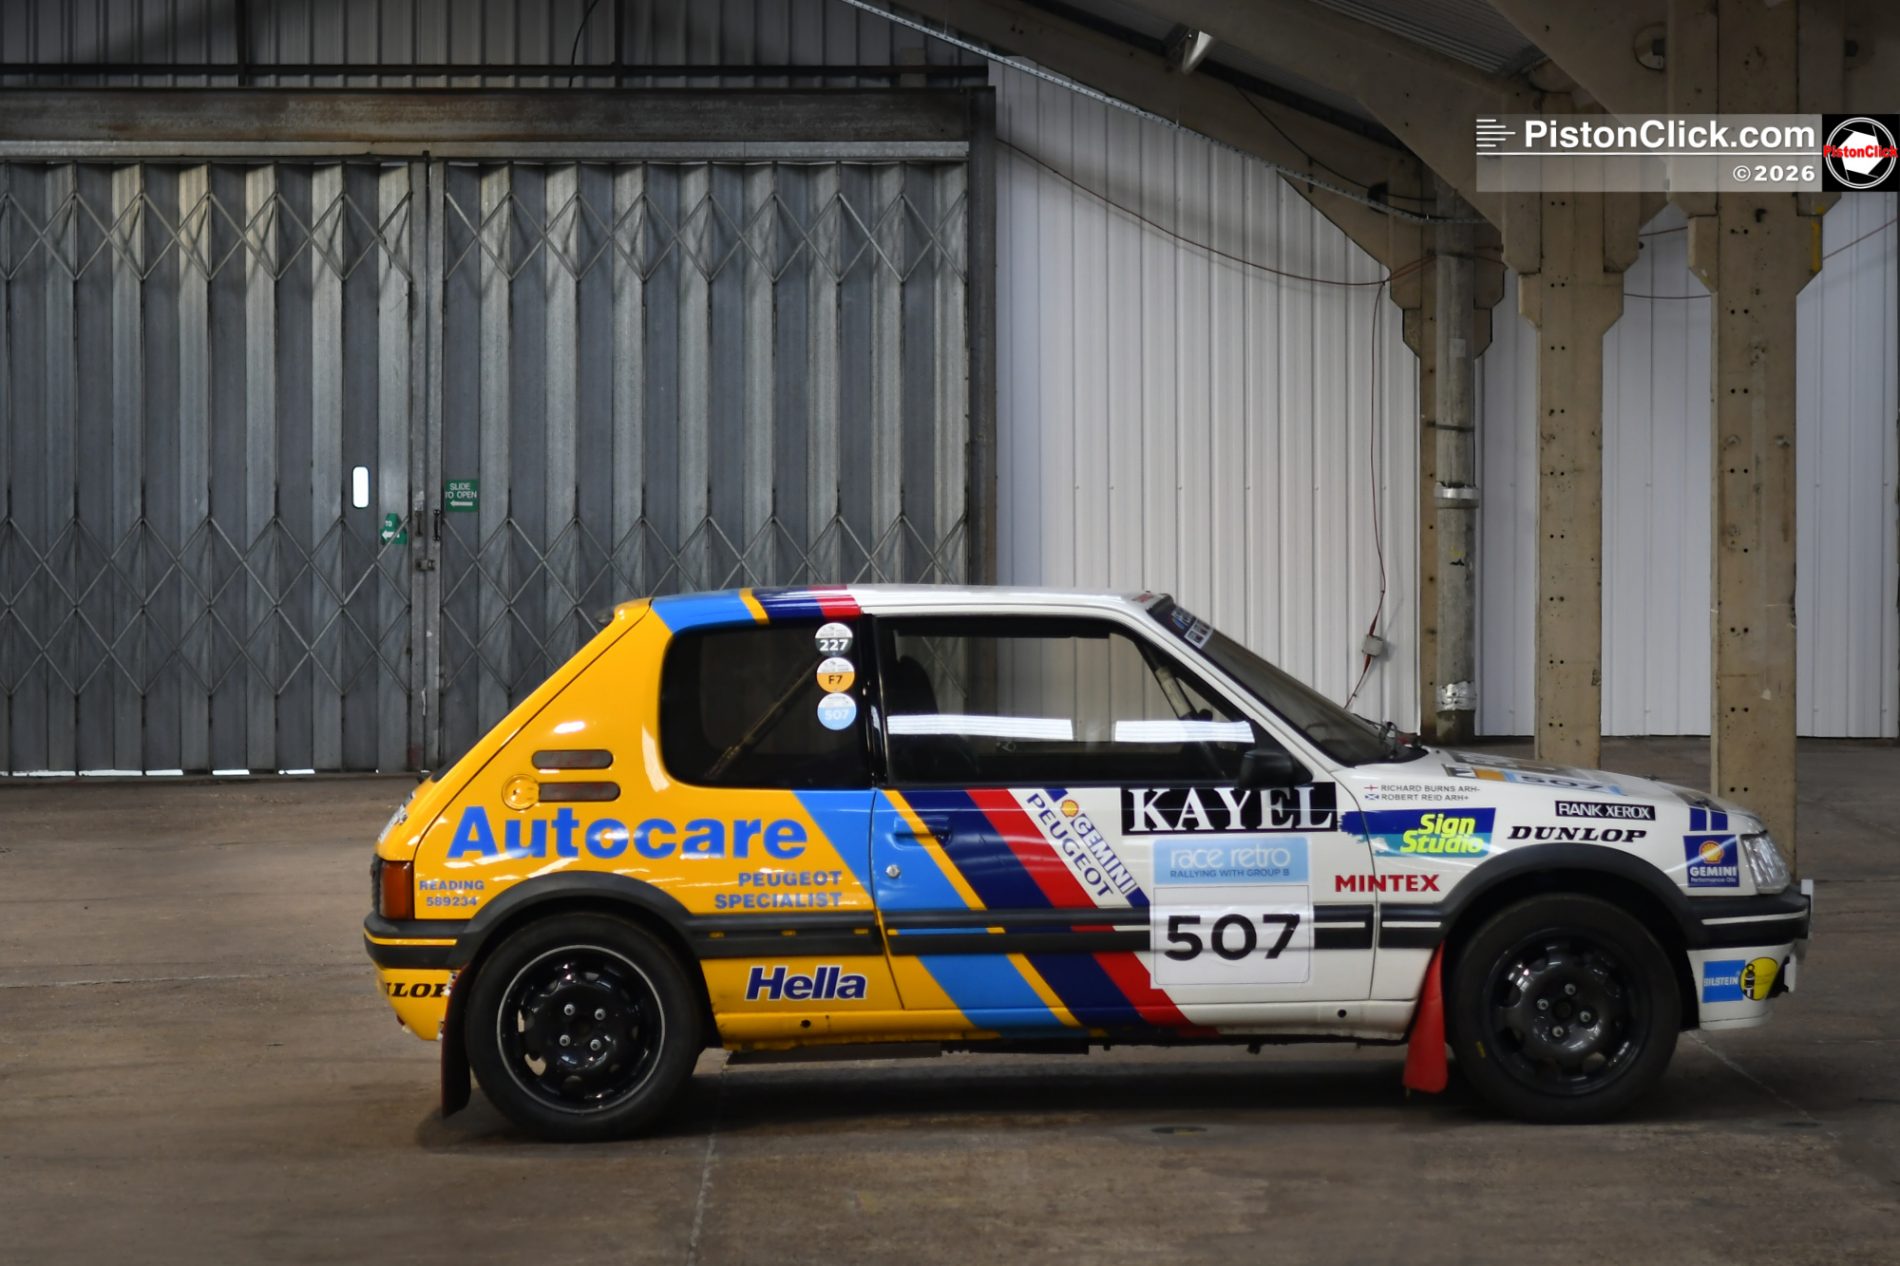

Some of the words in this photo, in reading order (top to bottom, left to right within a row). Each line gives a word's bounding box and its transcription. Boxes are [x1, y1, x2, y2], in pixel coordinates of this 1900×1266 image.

[449, 482, 471, 491] SLIDE
[457, 491, 477, 499] OPEN
[819, 638, 849, 652] 227
[828, 675, 843, 685] F7
[1381, 784, 1422, 793] RICHARD
[1424, 785, 1455, 793] BURNS
[1381, 793, 1420, 801] ROBERT
[1422, 793, 1443, 801] REID
[1127, 786, 1333, 832] KAYEL
[1557, 802, 1604, 817] RANK
[1604, 805, 1651, 820] XEROX
[446, 806, 808, 860] Autocare
[1417, 812, 1476, 836] Sign
[1399, 829, 1485, 855] Studio
[1507, 825, 1648, 843] DUNLOP
[1026, 792, 1115, 899] PEUGEOT
[1073, 815, 1137, 895] GEMINI
[1169, 846, 1224, 869] race
[1229, 842, 1292, 868] retro
[738, 871, 843, 887] PEUGEOT
[1169, 869, 1217, 878] RALLYING
[1219, 869, 1244, 878] WITH
[1245, 868, 1278, 878] GROUP
[1689, 866, 1737, 877] GEMINI
[418, 880, 485, 892] READING
[1335, 873, 1440, 893] MINTEX
[426, 896, 479, 908] 589234
[714, 891, 843, 909] SPECIALIST
[1164, 913, 1302, 961] 507
[745, 965, 867, 1001] Hella
[1703, 976, 1739, 987] BILSTEIN
